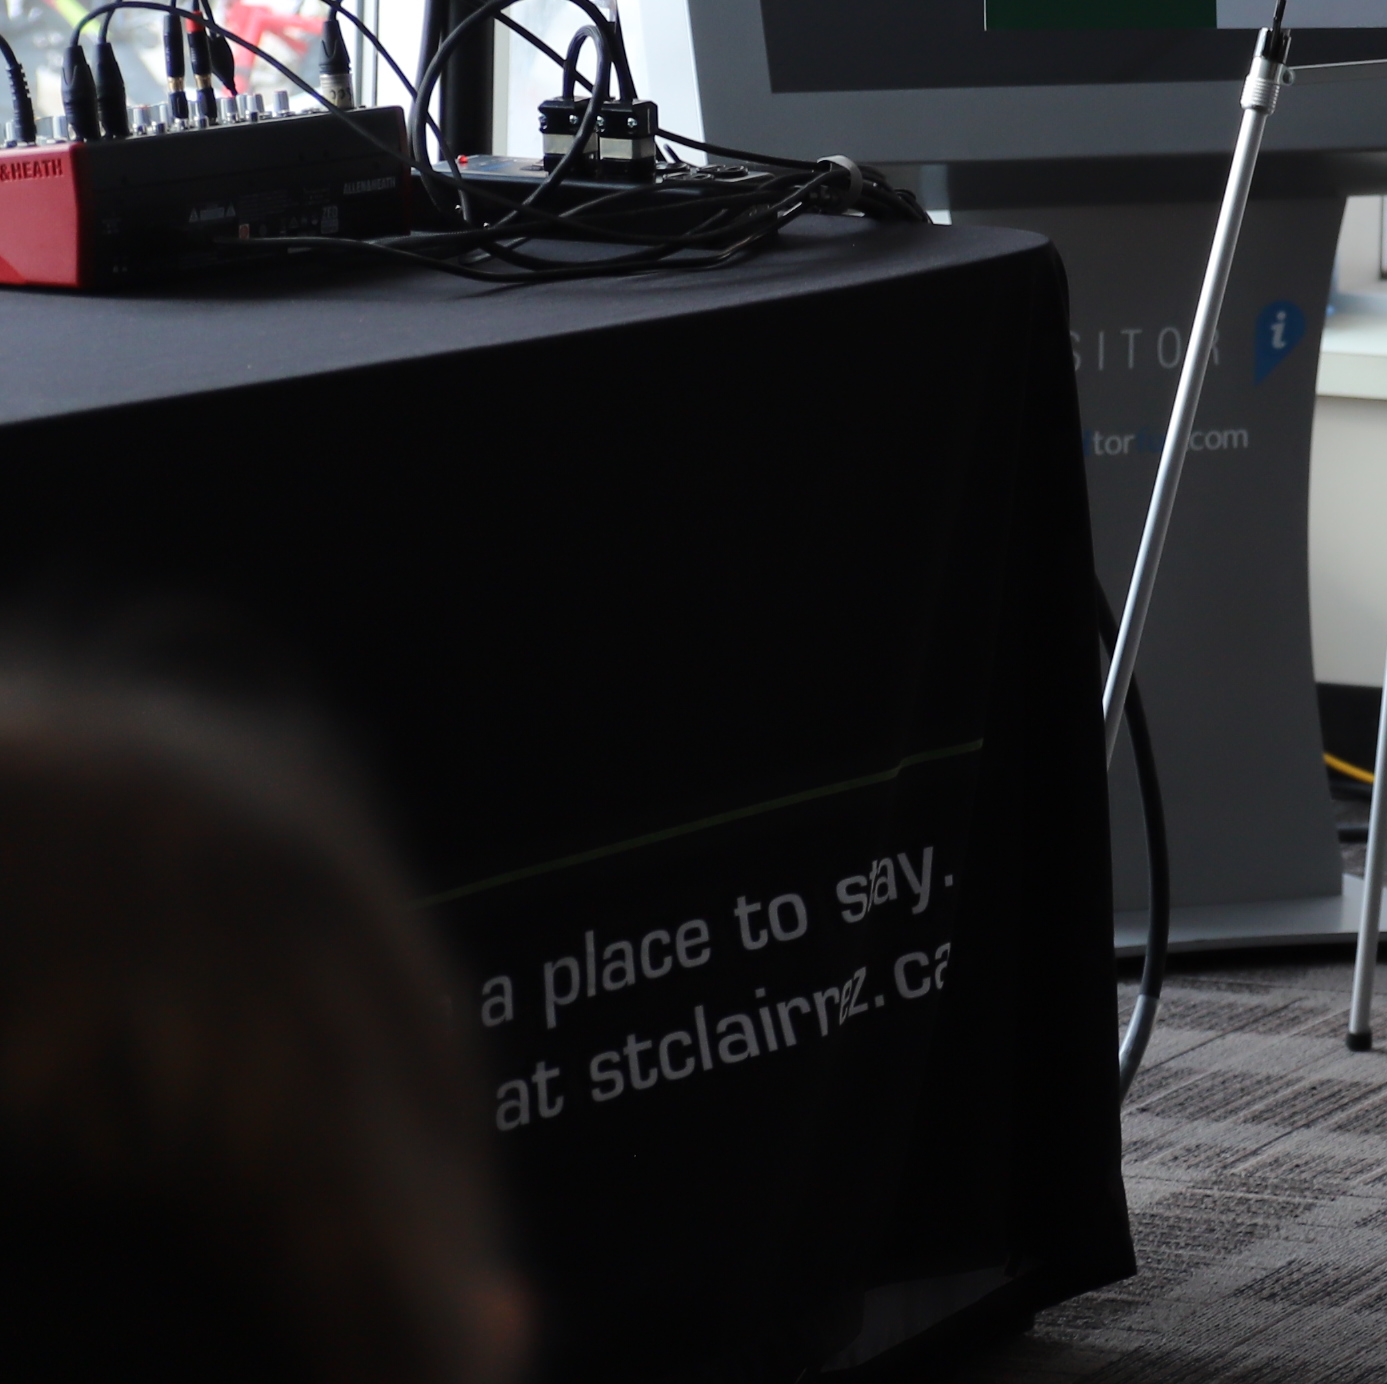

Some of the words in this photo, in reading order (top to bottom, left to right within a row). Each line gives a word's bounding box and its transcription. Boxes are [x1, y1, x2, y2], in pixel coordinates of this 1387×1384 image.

[0, 158, 63, 182] &HEATH
[480, 974, 514, 1027] a
[542, 918, 711, 1030] place
[734, 893, 808, 951] to
[495, 1060, 564, 1131] at
